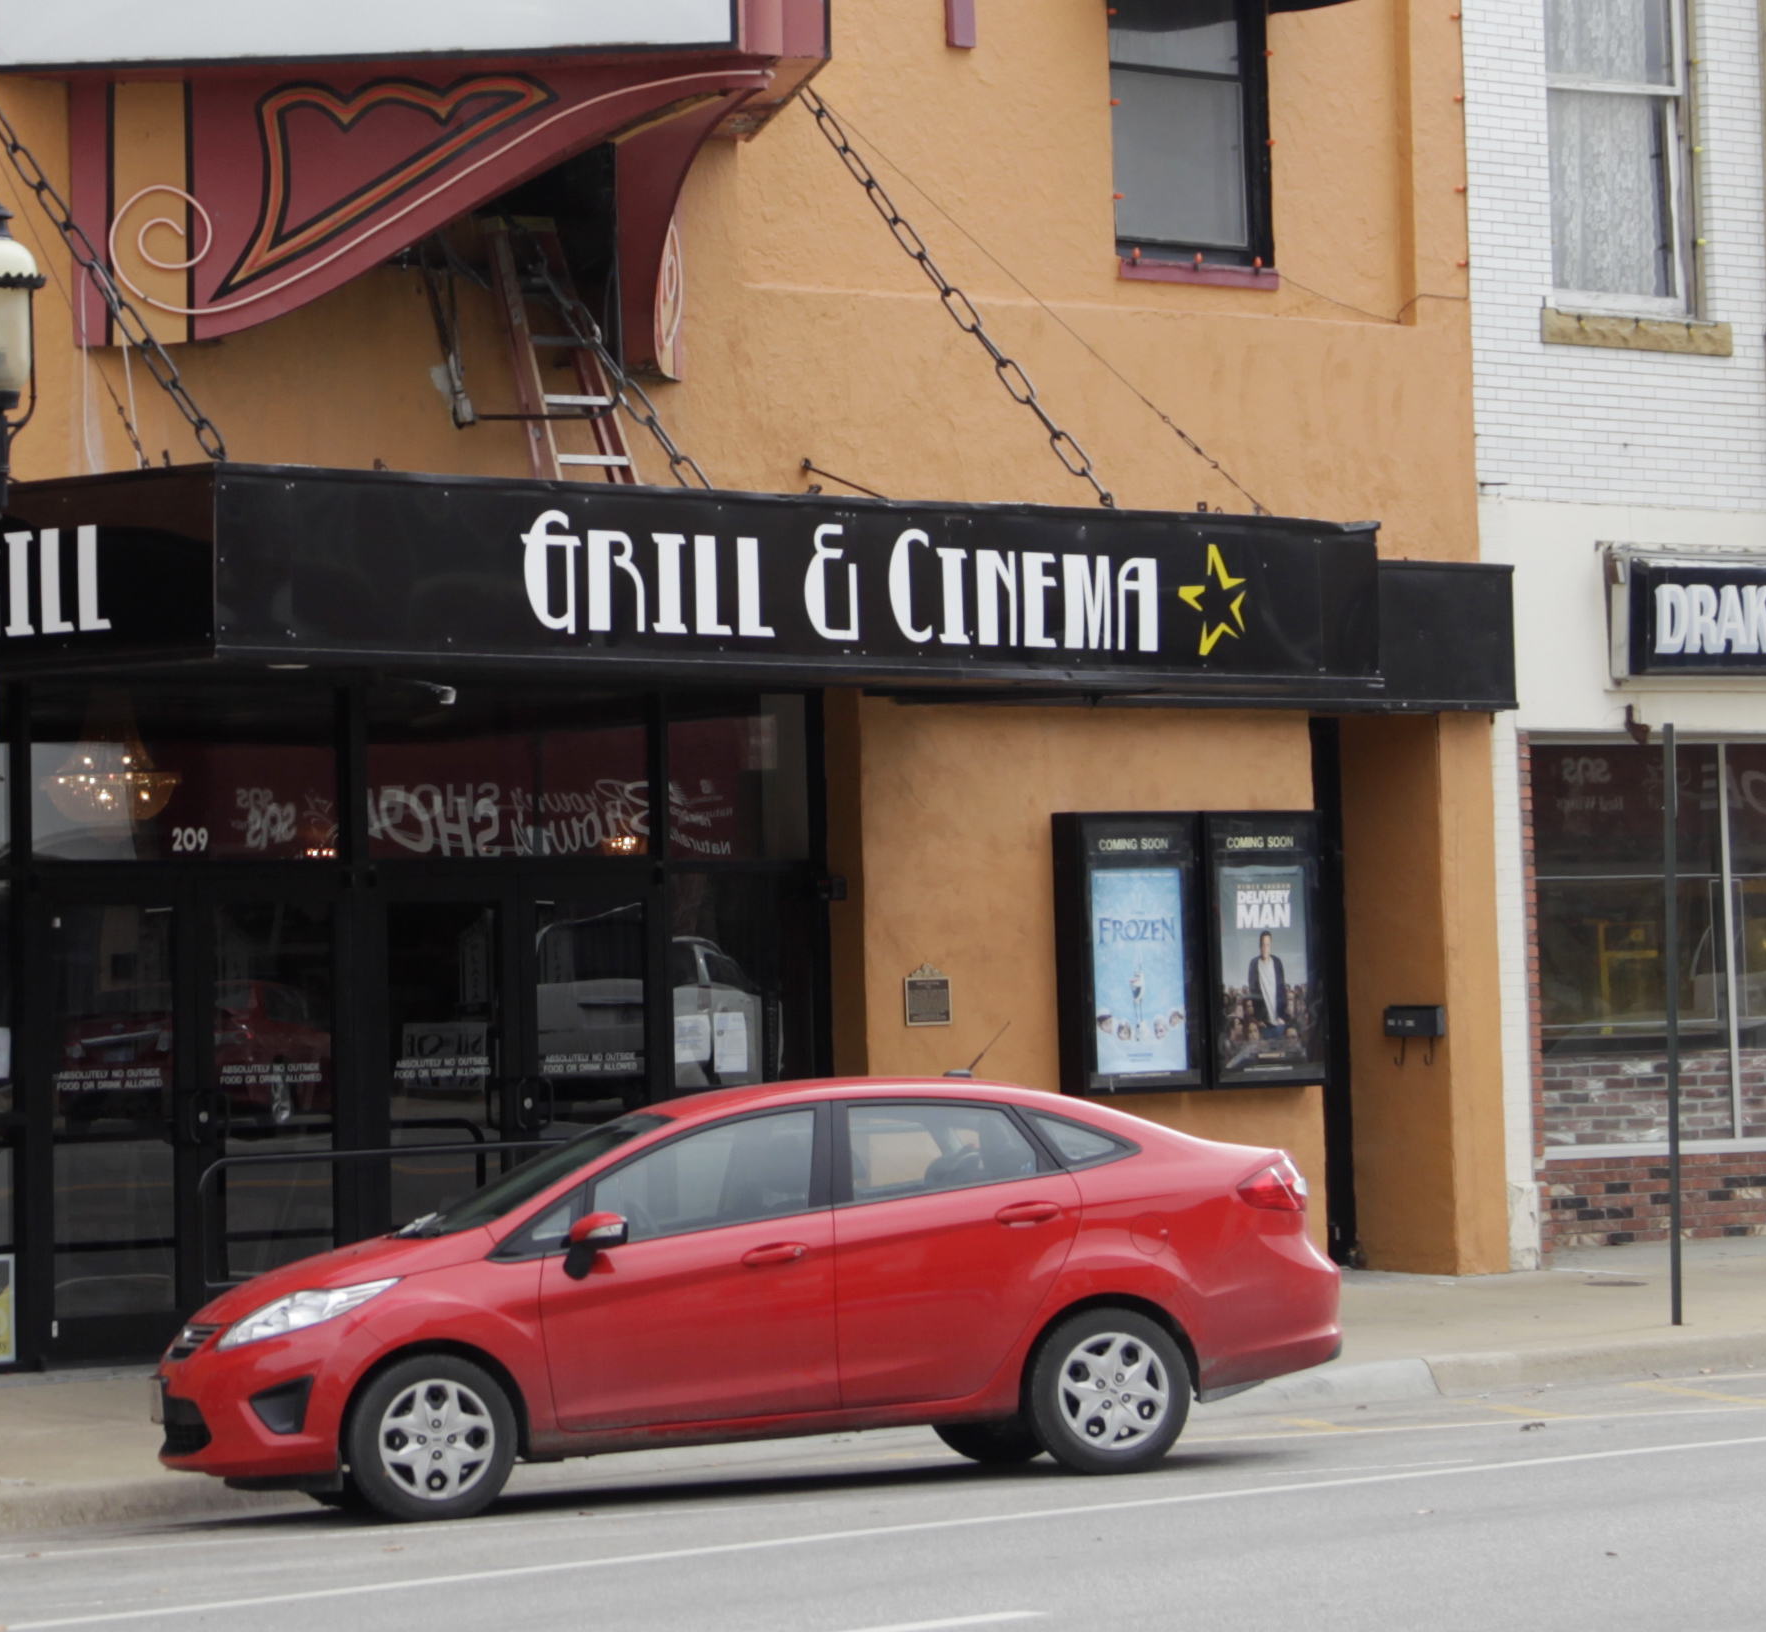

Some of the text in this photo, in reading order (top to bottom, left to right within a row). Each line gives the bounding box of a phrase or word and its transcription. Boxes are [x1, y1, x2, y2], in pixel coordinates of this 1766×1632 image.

[521, 509, 1159, 653] GRILL & CINEMA
[171, 827, 209, 852] 209
[1098, 838, 1169, 851] COMING SOON
[1226, 836, 1294, 848] COMING SOON
[1236, 889, 1291, 905] DELIVERY
[1236, 903, 1291, 929] MAN
[1098, 916, 1176, 944] FROZEN
[395, 1056, 490, 1068] ABSOLUTELY NO OUTSIDE
[544, 1051, 636, 1063] ABSOLUTELY NO OUTSIDE
[57, 1067, 161, 1081] ABSOLUTELY NO OUTSIDE
[221, 1062, 321, 1075] ABSOLUTELY NO OUTSIDE
[394, 1066, 492, 1079] FOOD OR DRINK ALLOWED
[543, 1061, 638, 1074] FOOD OR DRINK ALLOWED
[56, 1078, 163, 1091] FOOD OR DRINK ALLOWED
[219, 1072, 323, 1085] FOOD OR DRINK ALLOWED
